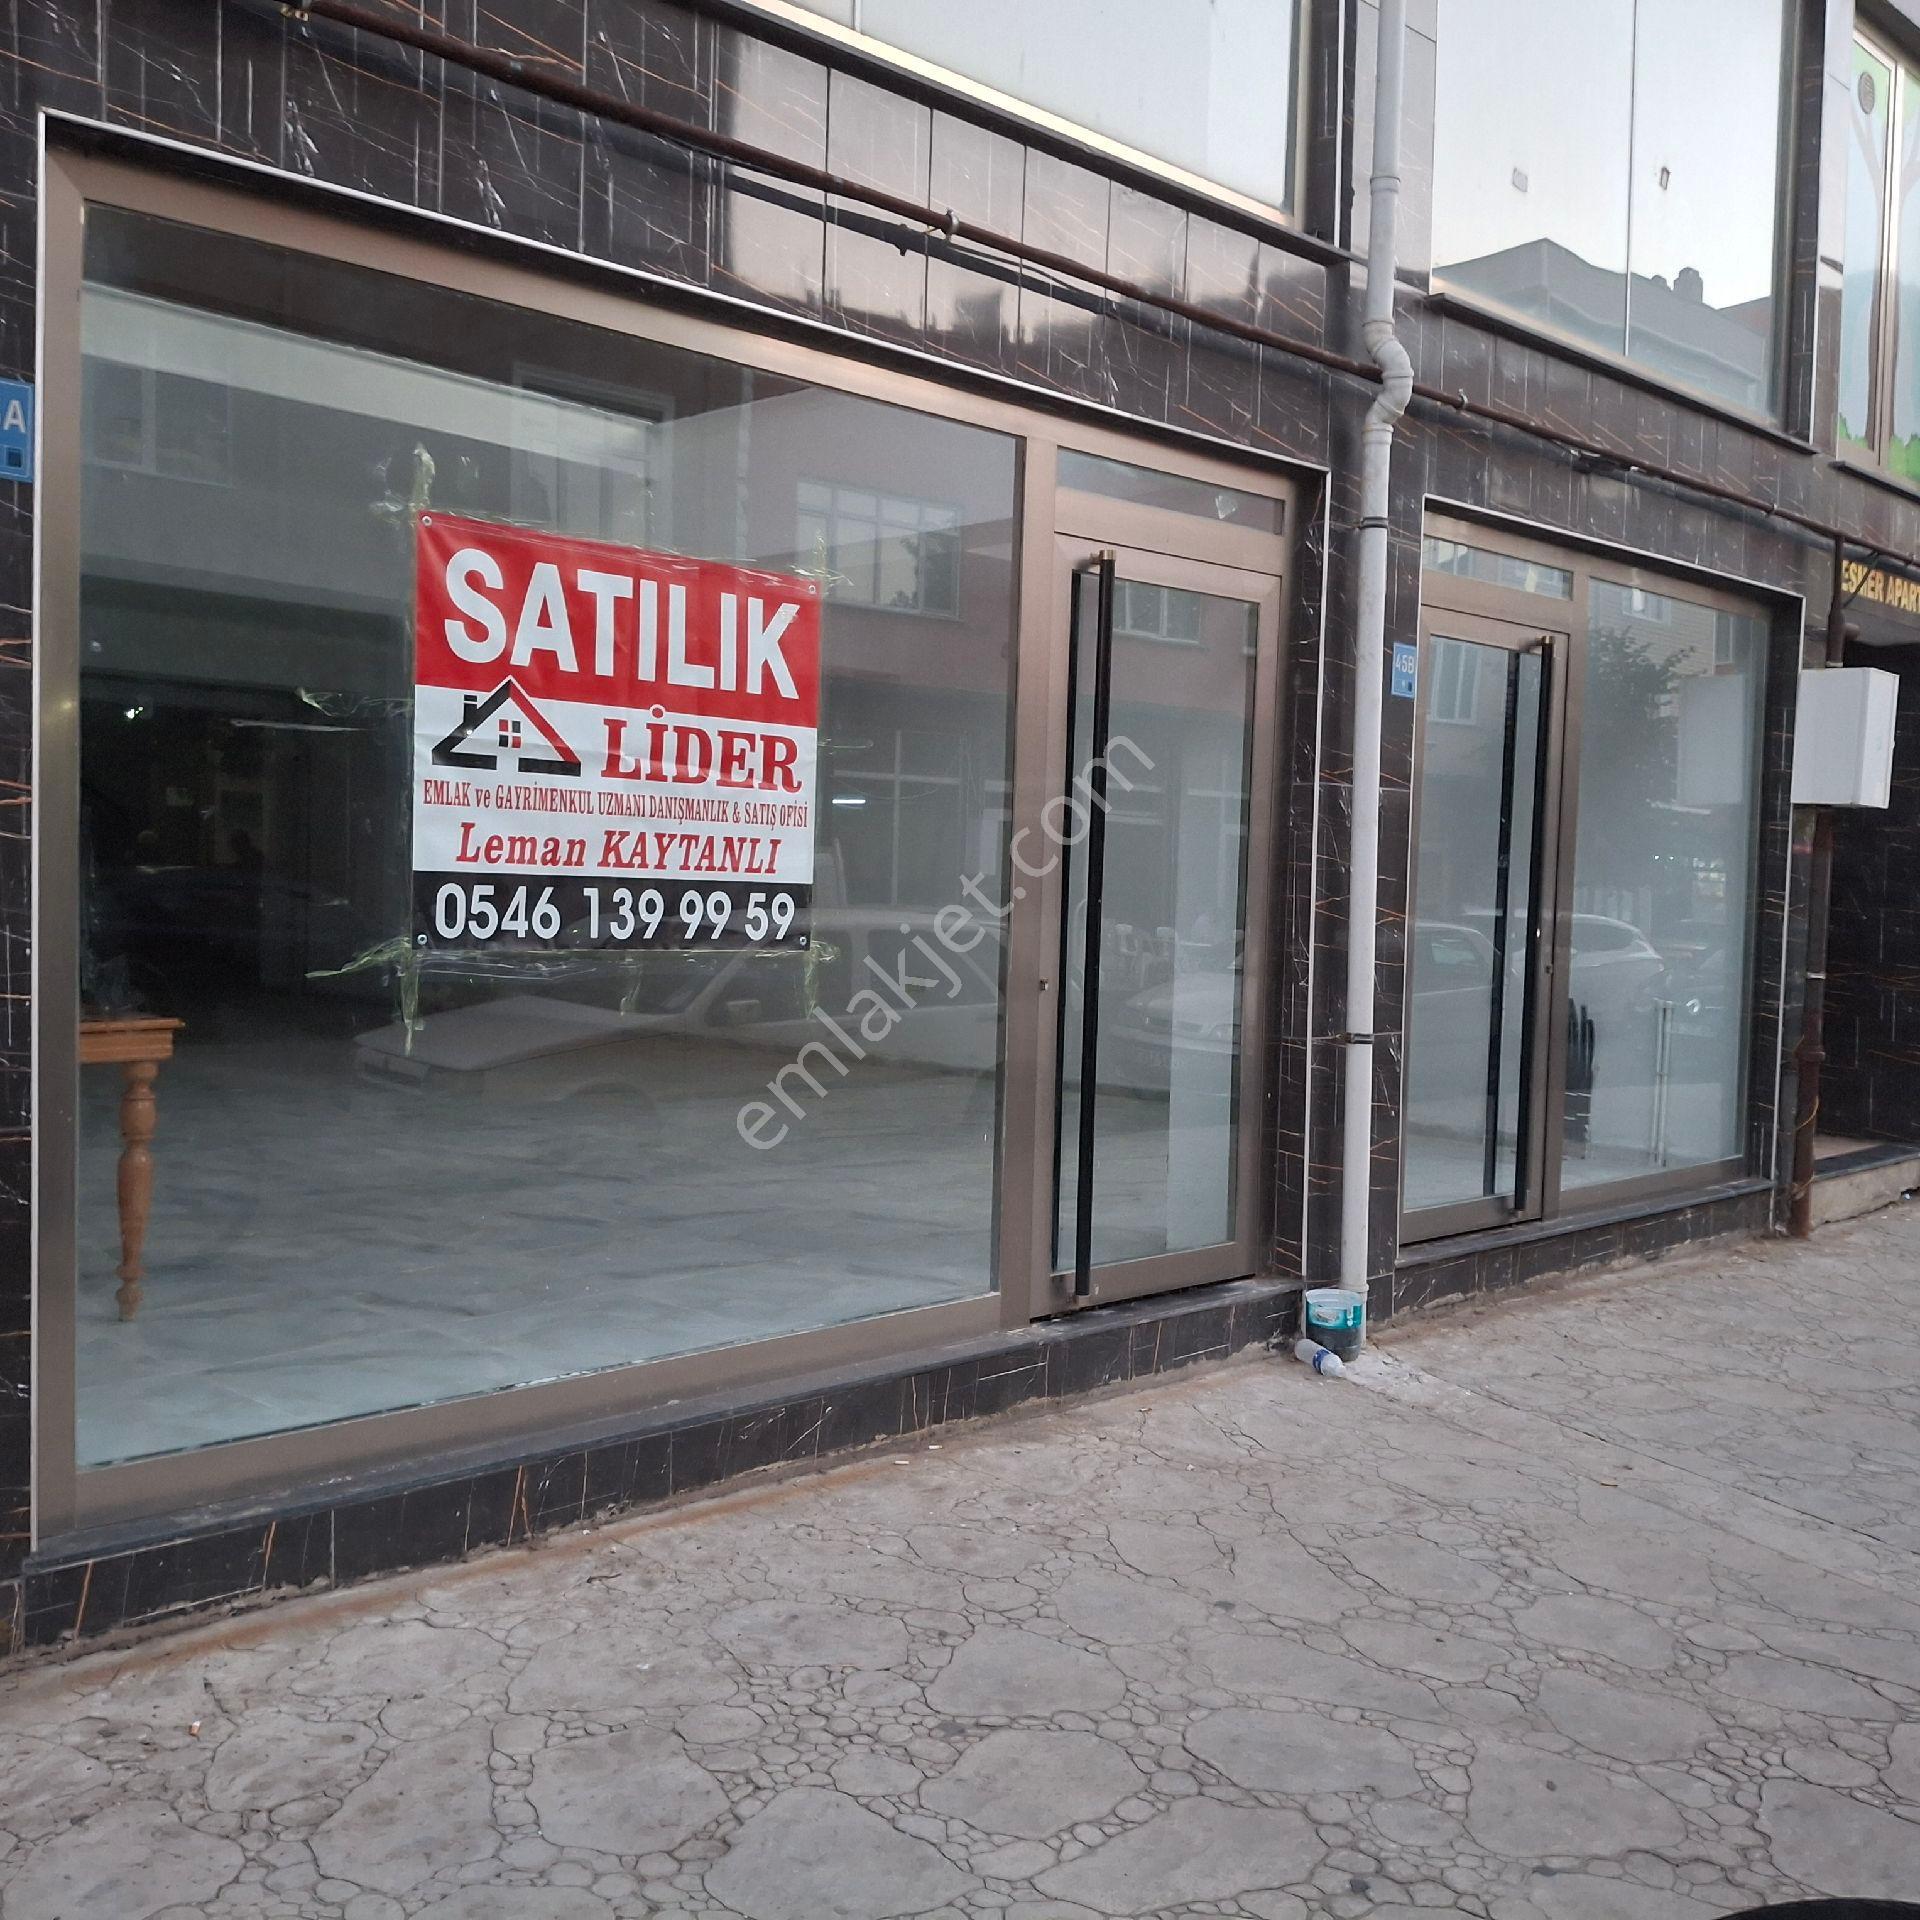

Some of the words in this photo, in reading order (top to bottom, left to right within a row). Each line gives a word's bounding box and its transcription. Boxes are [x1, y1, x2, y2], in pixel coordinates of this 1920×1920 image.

[444, 547, 800, 700] SATILIK
[600, 704, 802, 793] LİDER
[423, 779, 471, 806] EMLAK
[475, 787, 491, 808] ve
[496, 781, 594, 815] GAYRİMENKUL
[597, 791, 646, 817] UZMANI
[649, 795, 729, 825] DANIŞMANLIK
[732, 801, 741, 824] &
[744, 801, 776, 831] SATIŞ
[456, 821, 587, 867] Leman
[597, 829, 782, 874] KAYTANLI
[435, 882, 562, 940] 0546
[583, 886, 665, 941] 139
[679, 890, 732, 941] 99
[744, 891, 795, 941] 59
